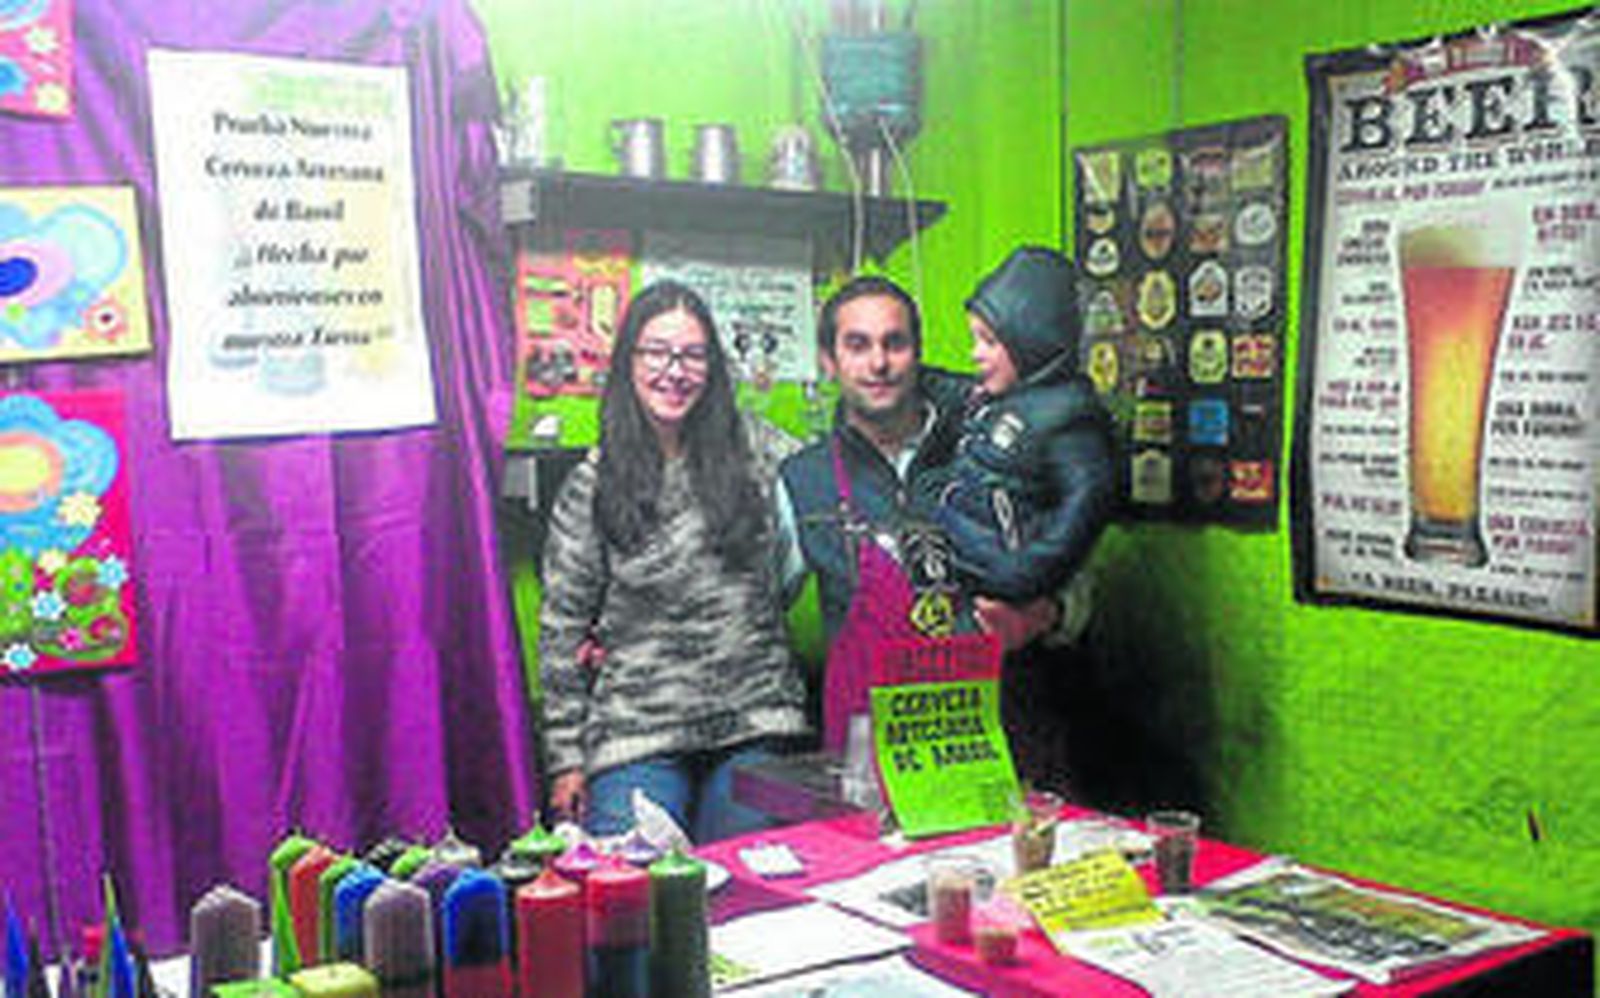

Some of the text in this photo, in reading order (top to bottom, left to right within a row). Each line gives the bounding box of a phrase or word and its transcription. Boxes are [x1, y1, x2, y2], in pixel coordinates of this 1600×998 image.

[1338, 156, 1439, 181] AROUND
[1448, 152, 1494, 173] THE
[892, 687, 981, 716] CERVEZA
